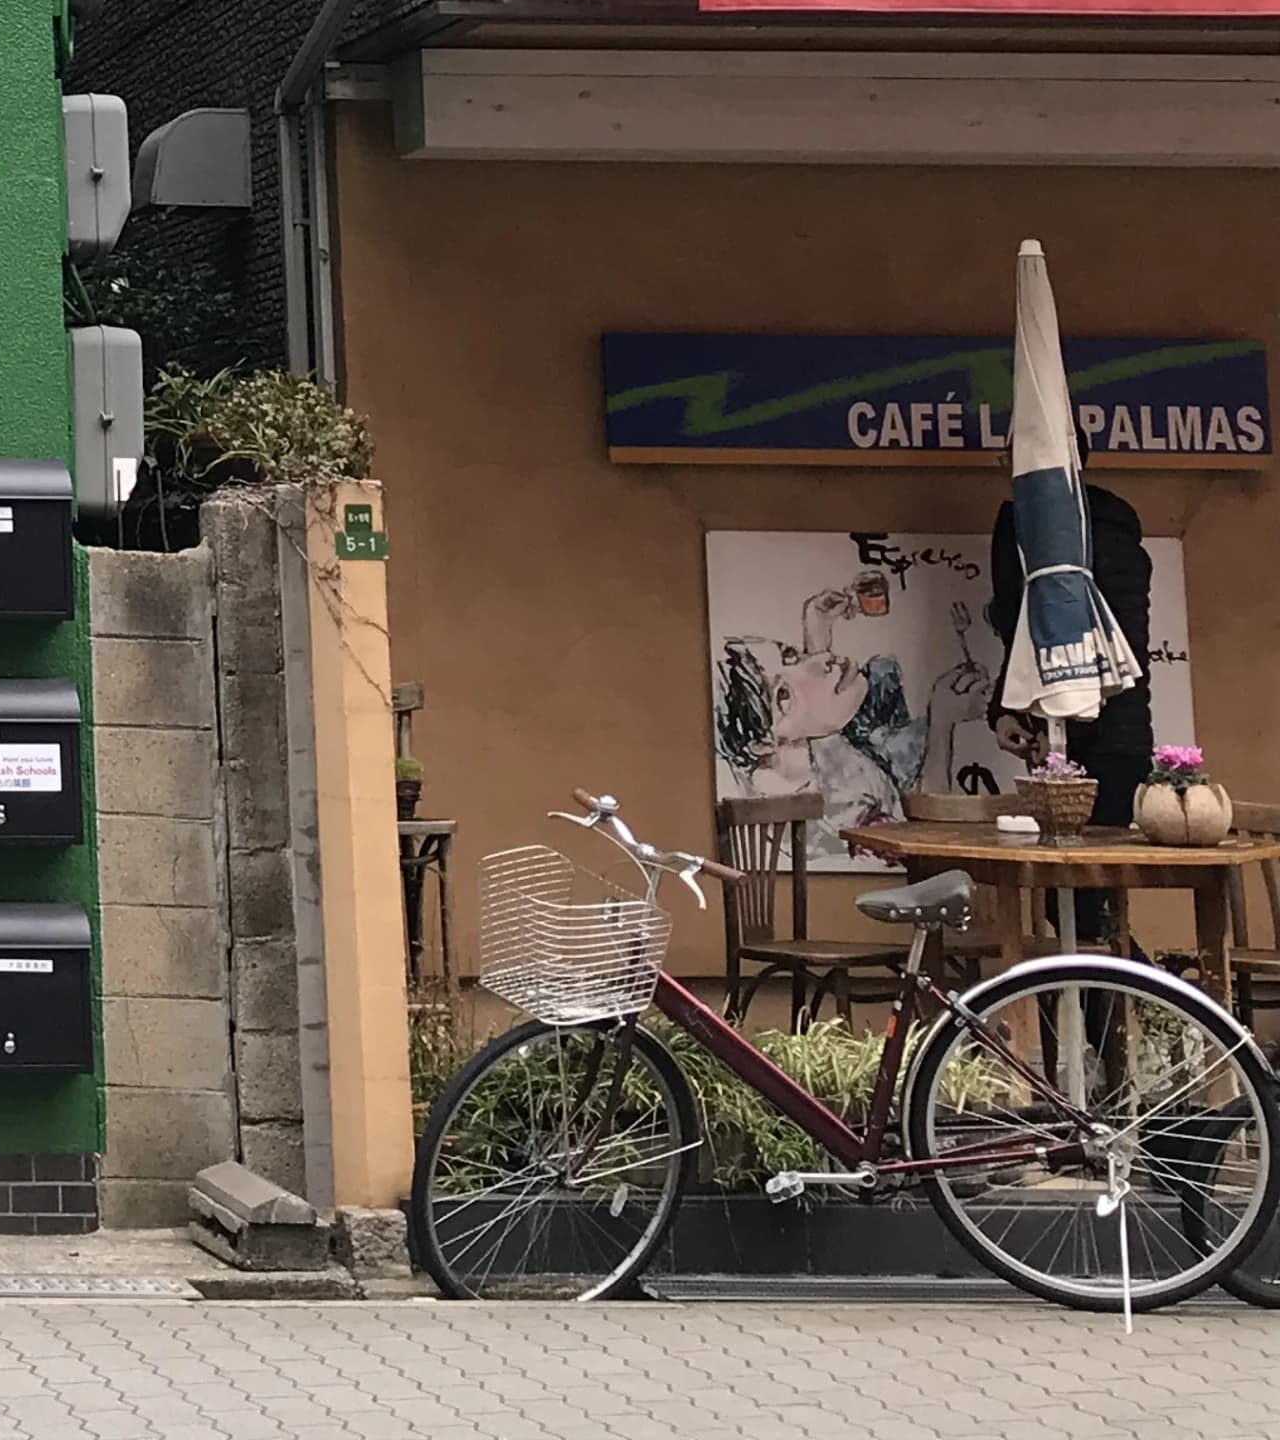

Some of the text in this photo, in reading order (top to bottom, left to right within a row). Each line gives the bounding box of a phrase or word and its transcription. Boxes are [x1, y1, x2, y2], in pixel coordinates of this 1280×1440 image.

[847, 392, 966, 449] CAFÉ
[1080, 404, 1267, 453] PALMAS
[345, 537, 377, 552] 5-1
[16, 766, 57, 776] Schools
